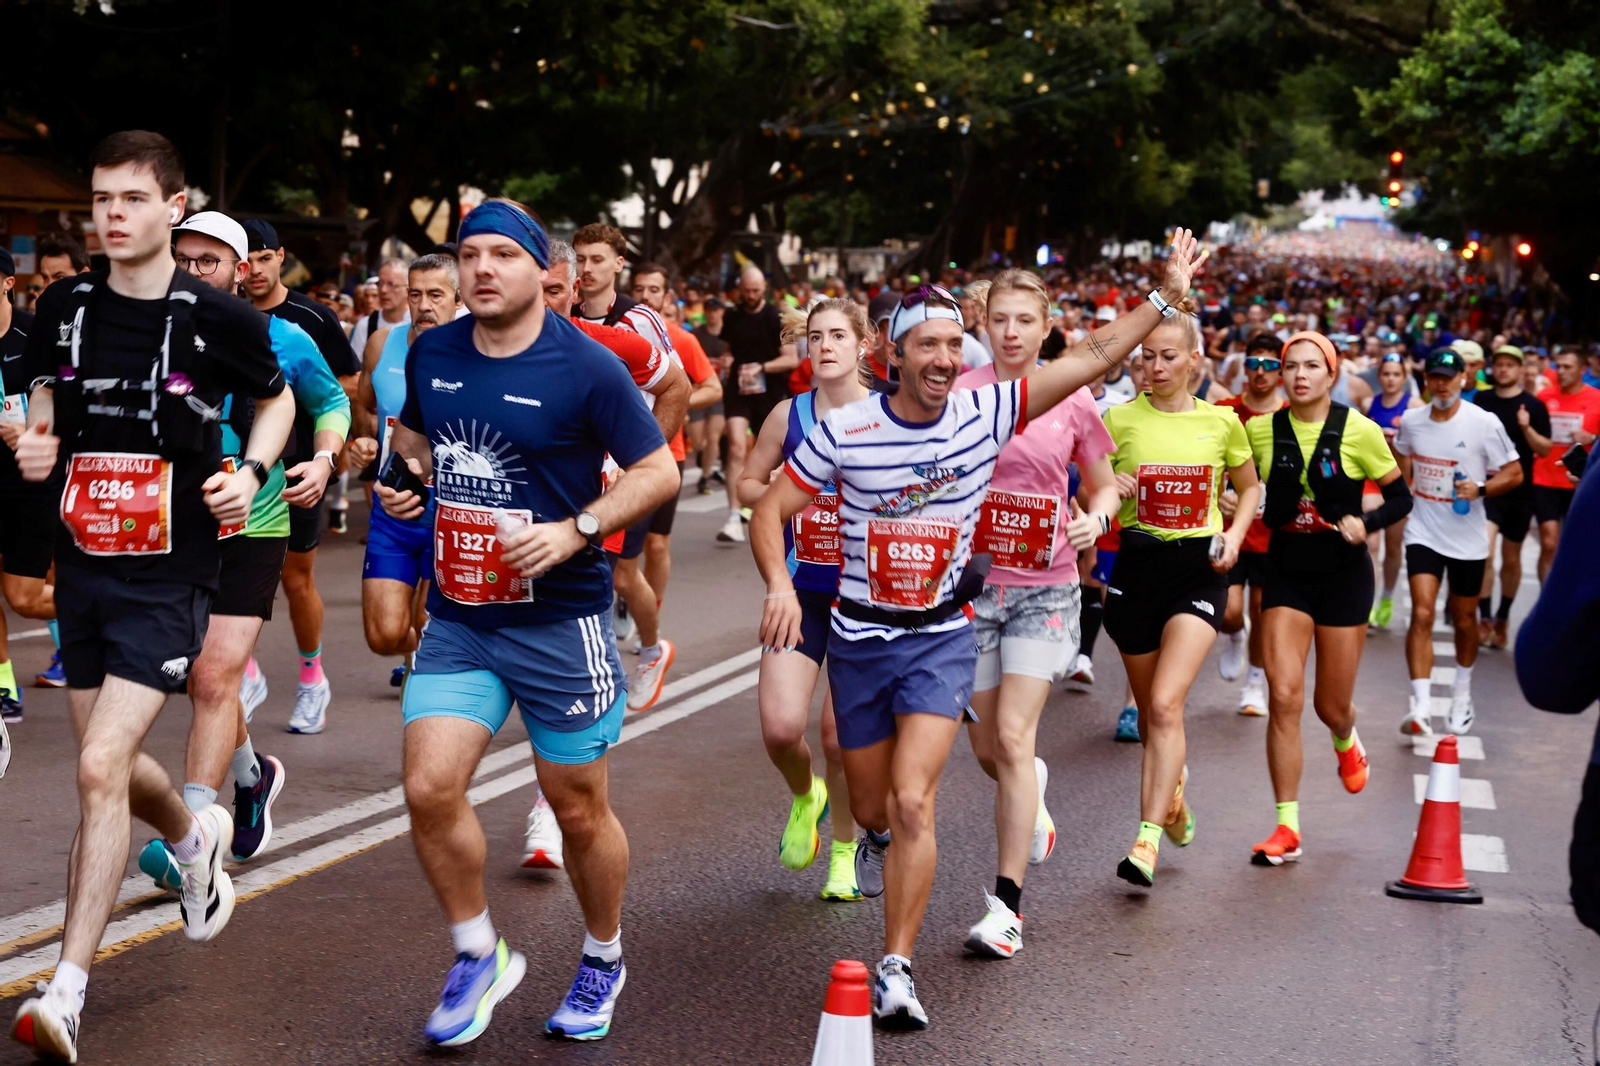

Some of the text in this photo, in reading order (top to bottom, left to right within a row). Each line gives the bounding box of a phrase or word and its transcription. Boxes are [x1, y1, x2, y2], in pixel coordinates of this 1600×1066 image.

[1158, 466, 1204, 476] GENERALI
[88, 480, 136, 501] 6286
[1155, 481, 1192, 494] 6722
[993, 493, 1047, 511] GENERALI
[990, 509, 1031, 529] 1328
[451, 530, 496, 552] 1327
[891, 523, 951, 540] GENERALI
[888, 541, 936, 562] 6263
